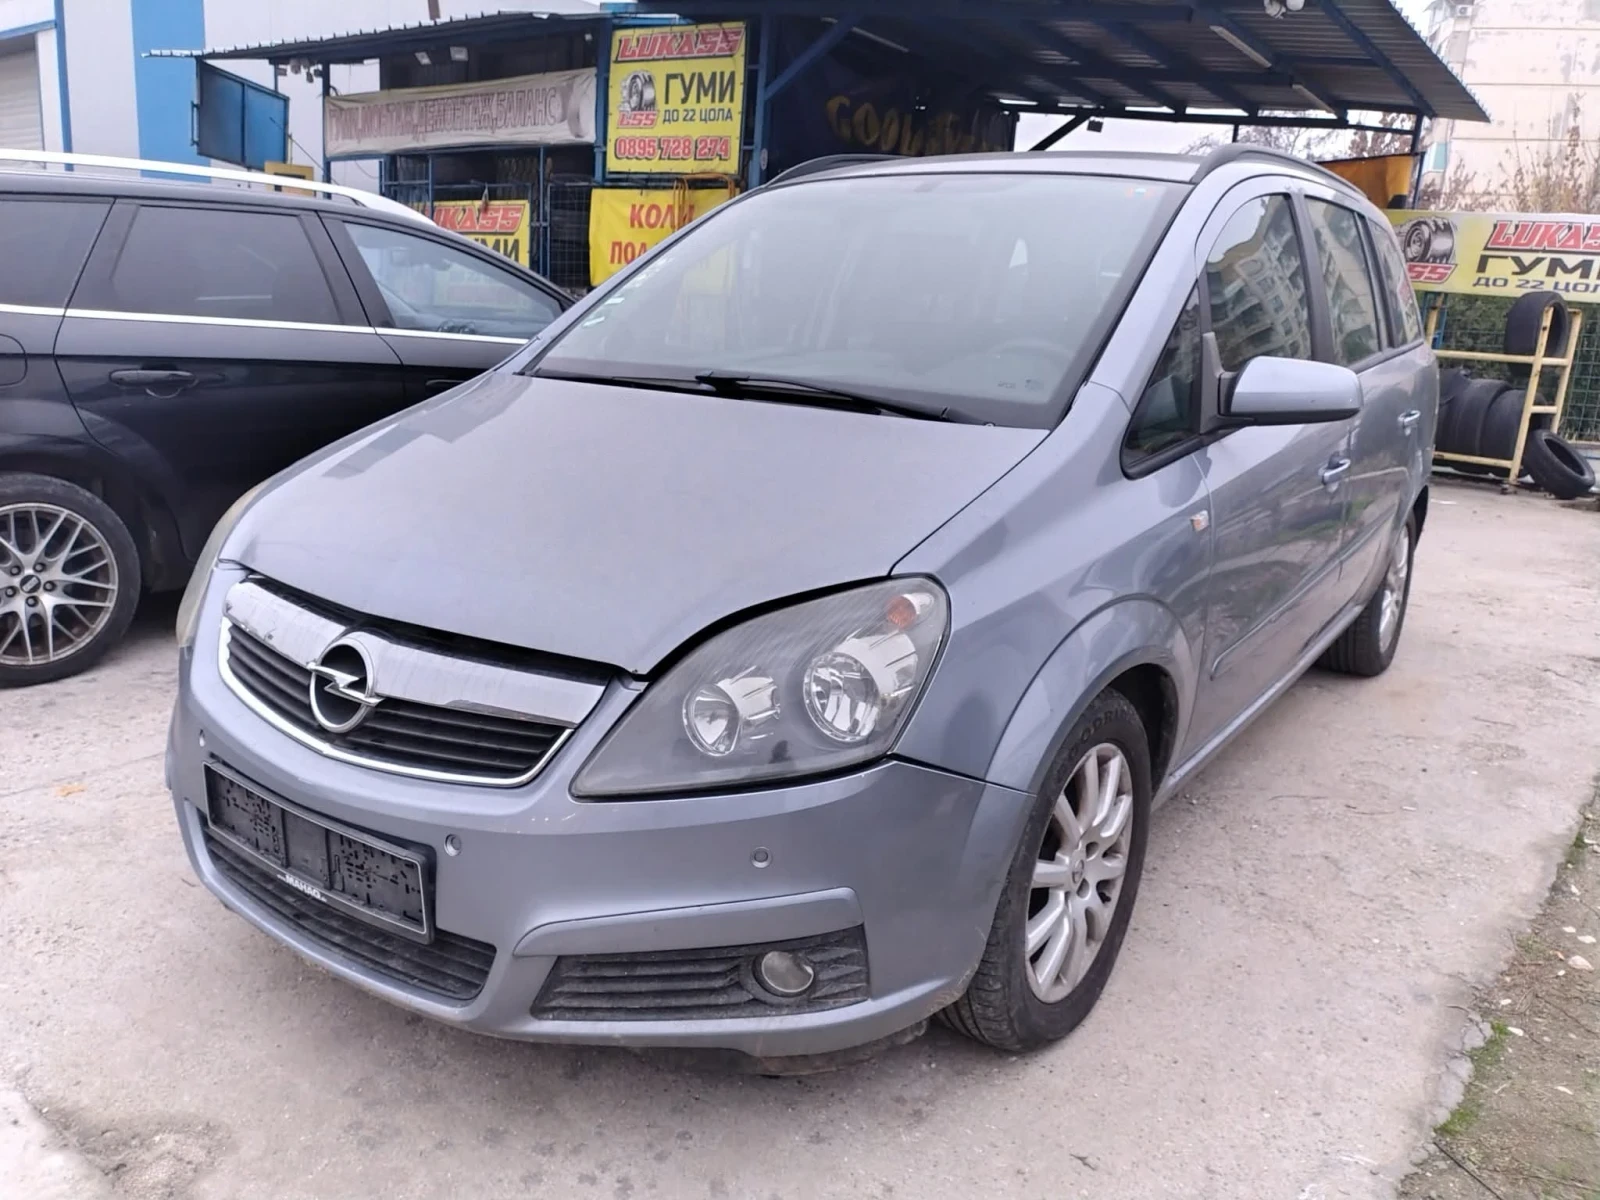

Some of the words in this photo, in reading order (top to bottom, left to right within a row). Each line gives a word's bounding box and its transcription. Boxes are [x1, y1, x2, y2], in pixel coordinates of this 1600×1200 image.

[616, 28, 744, 62] LUKASS
[664, 71, 736, 105] ГУМИ
[617, 111, 657, 129] LSS
[662, 110, 680, 125] ДО
[682, 109, 696, 122] 22
[699, 108, 733, 124] ЦОЛА
[616, 137, 659, 160] 0895
[661, 136, 693, 160] 728
[695, 136, 732, 161] 274
[1407, 262, 1457, 284] SS
[1476, 254, 1600, 280] ГУМ
[1472, 277, 1509, 288] ДО
[1515, 279, 1545, 290] 22
